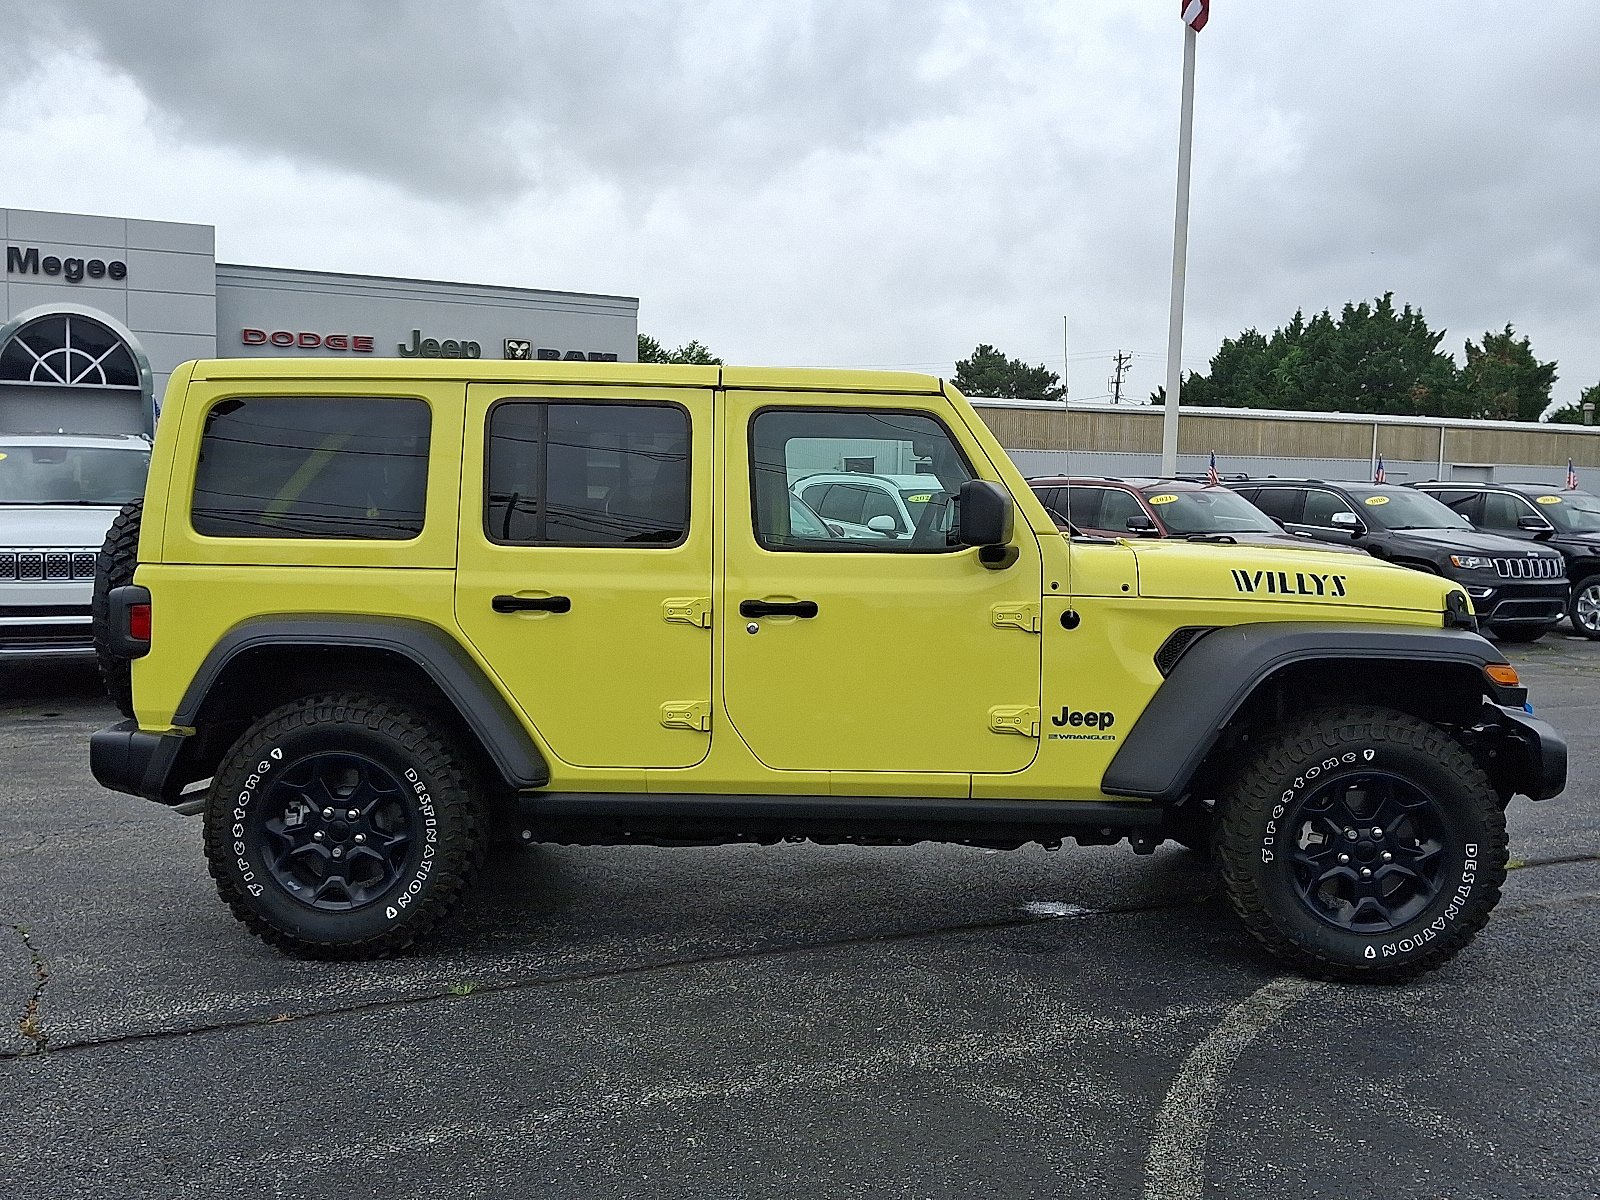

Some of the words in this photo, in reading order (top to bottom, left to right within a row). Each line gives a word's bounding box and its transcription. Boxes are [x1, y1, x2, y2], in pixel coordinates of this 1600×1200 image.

[7, 246, 127, 284] Megee
[242, 328, 375, 352] DODGE
[398, 329, 482, 359] Jeep
[537, 348, 618, 362] RAM
[1230, 569, 1347, 597] WILLYS
[1051, 706, 1115, 731] Jeep
[1059, 733, 1116, 741] WRANGLER
[1262, 752, 1357, 863] Firestone
[232, 761, 271, 897] Firestone
[398, 768, 437, 908] DESTINATION
[1382, 843, 1478, 957] DESTINATION
